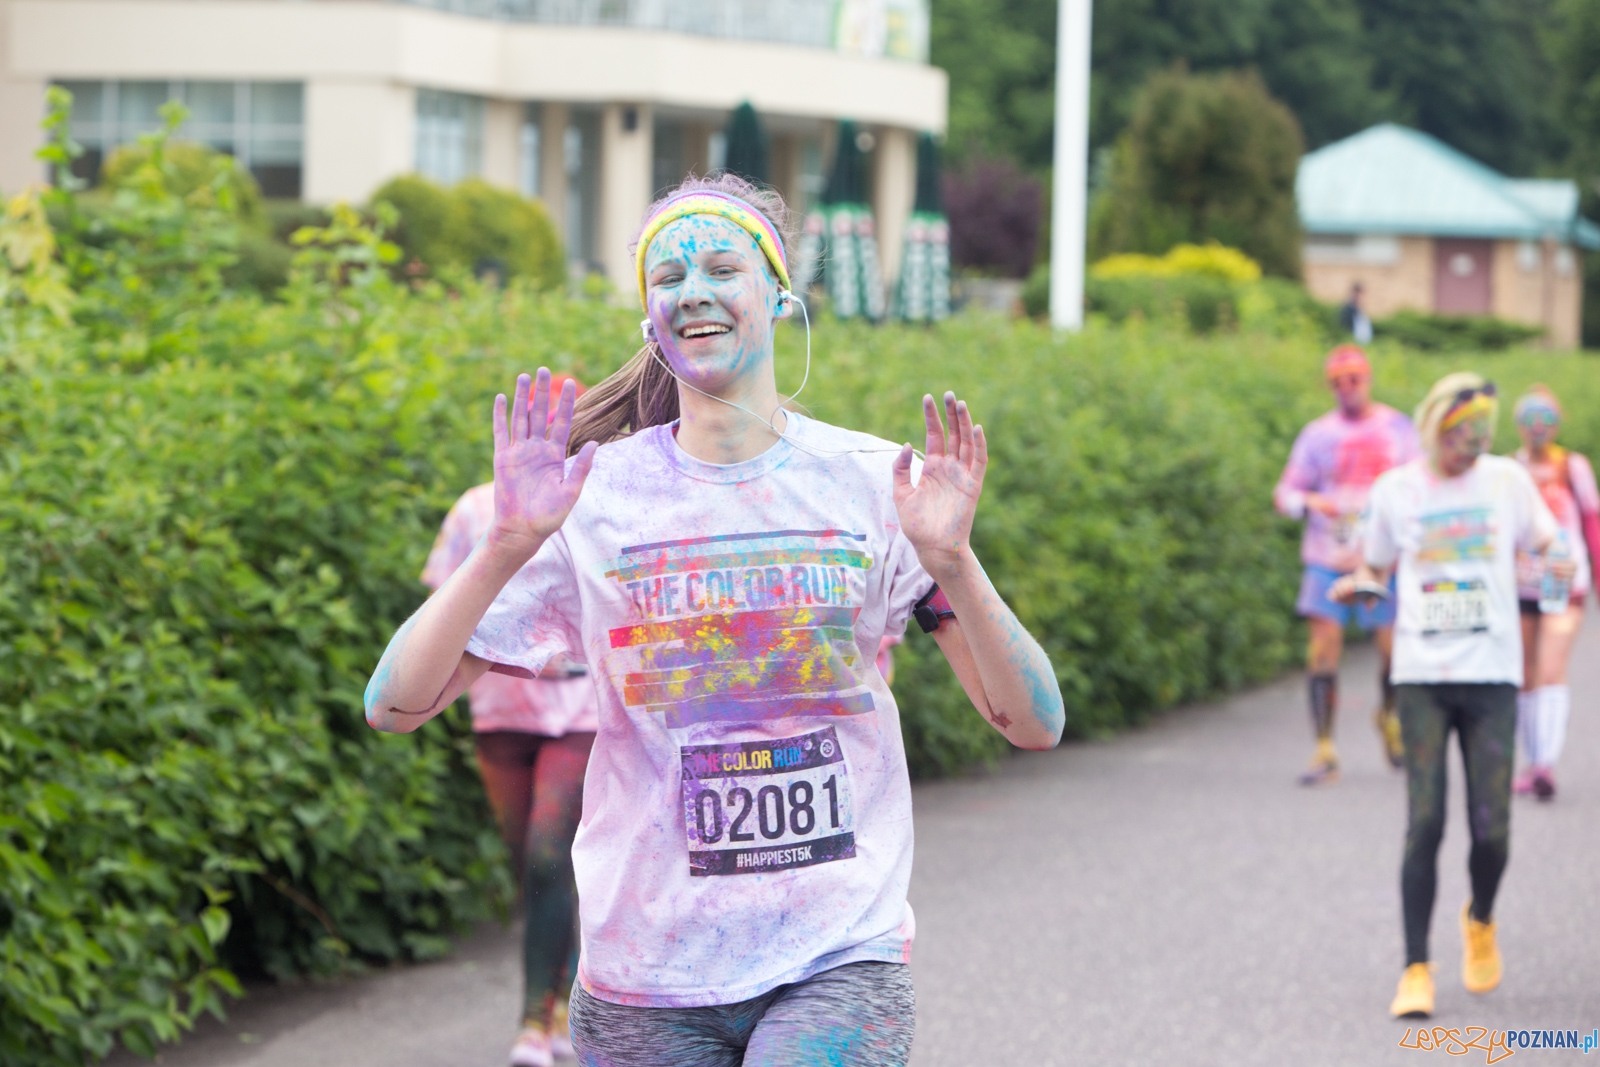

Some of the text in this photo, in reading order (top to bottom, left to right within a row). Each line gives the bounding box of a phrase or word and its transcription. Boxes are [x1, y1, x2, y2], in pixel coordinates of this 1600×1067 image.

[626, 575, 680, 617] THE
[685, 568, 785, 613] COLOR
[722, 749, 772, 772] COLOR
[695, 774, 839, 844] 02081
[736, 846, 812, 868] #HAPPIEST5K
